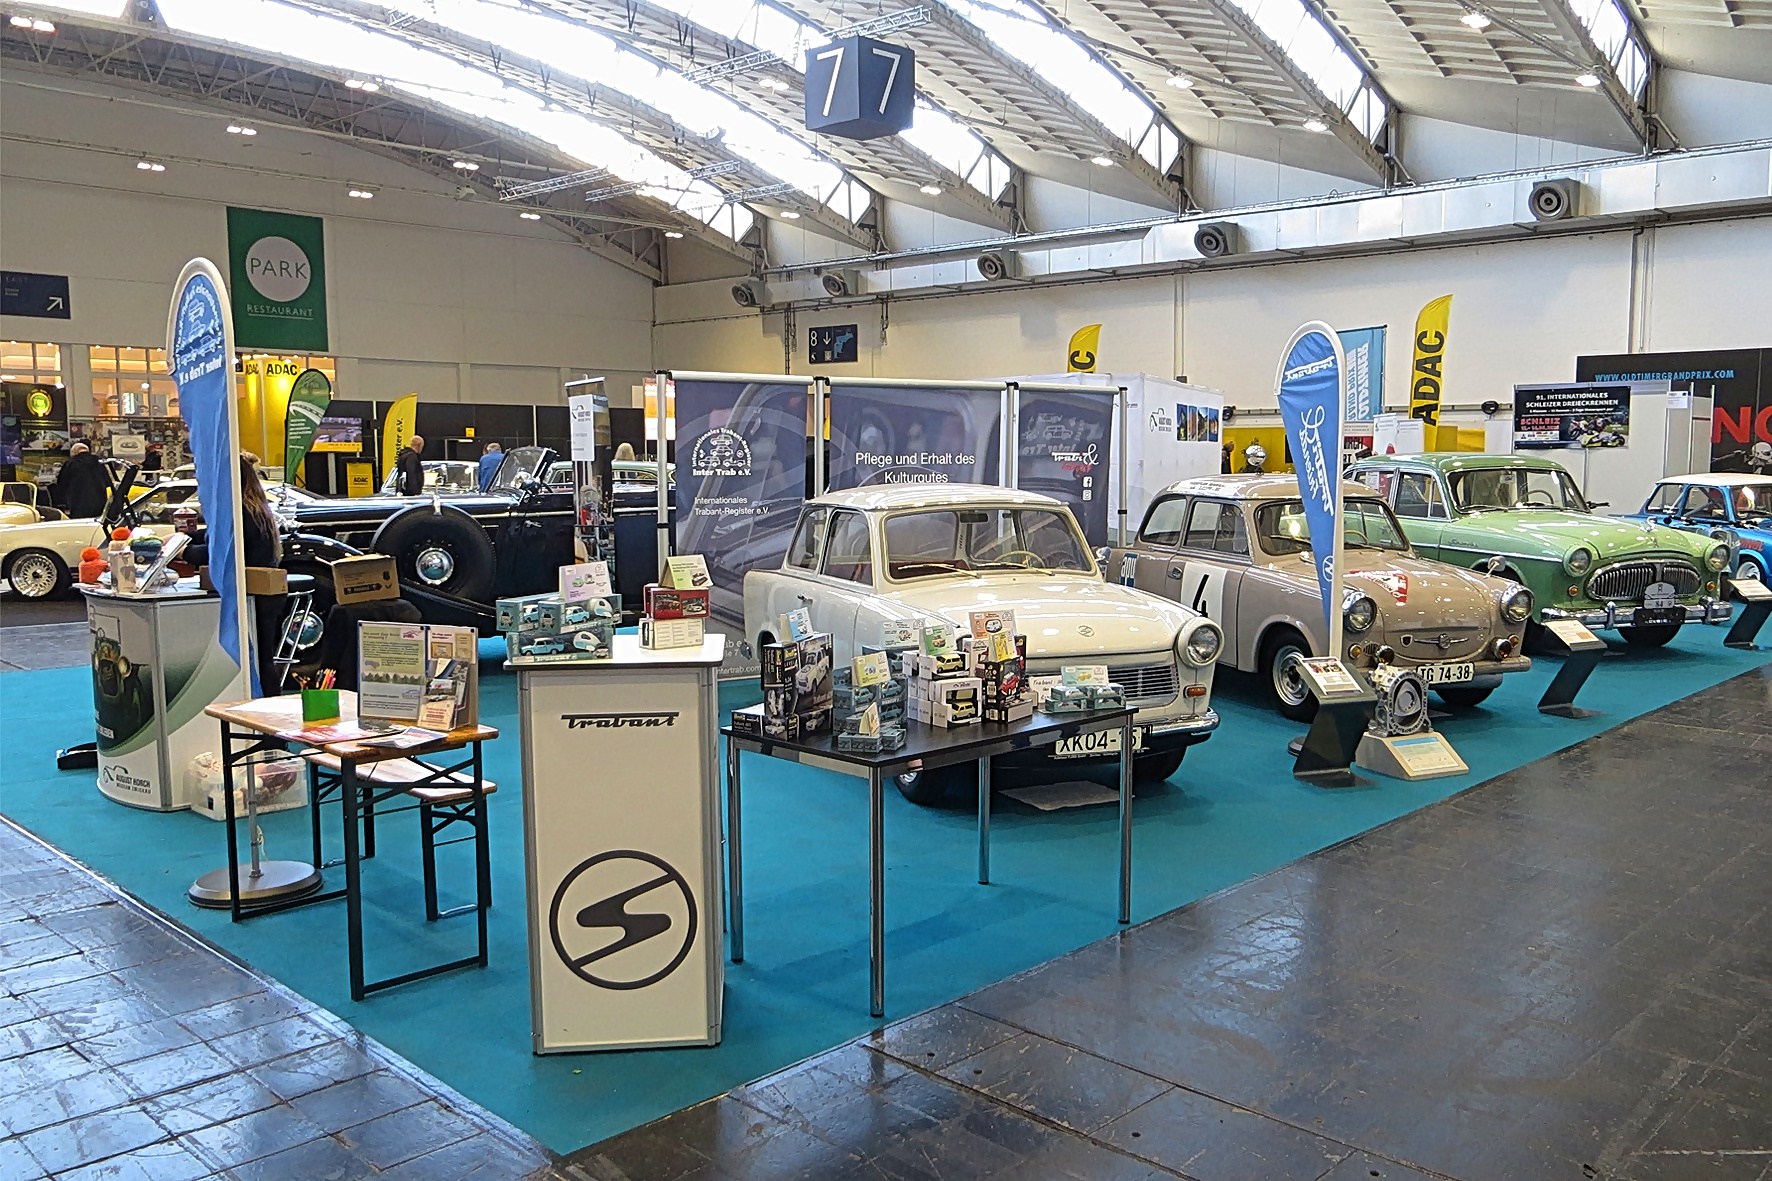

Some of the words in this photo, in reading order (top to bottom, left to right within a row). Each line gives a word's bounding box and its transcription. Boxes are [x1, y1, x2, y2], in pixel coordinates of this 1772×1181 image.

[816, 47, 845, 117] 7
[872, 48, 901, 114] 7
[250, 258, 307, 280] PARK
[247, 304, 313, 316] RESTAURANT
[810, 330, 818, 346] 8
[266, 363, 298, 376] ADAC
[1070, 350, 1095, 373] C
[1412, 330, 1445, 427] ADAC
[1595, 369, 1735, 382] WWW.OLDTIMERGRANDPRIX.COM
[1547, 392, 1609, 401] INTERNATIONALES
[855, 452, 892, 468] Pflege
[895, 452, 917, 465] und
[920, 452, 952, 465] Erhalt
[955, 453, 975, 465] des
[715, 468, 737, 476] Trab
[738, 468, 752, 476] e.V.
[884, 471, 949, 483] Kulturgutes
[694, 496, 748, 505] Internationales
[694, 506, 754, 516] Trabant-Register
[756, 506, 770, 515] e.V.
[1439, 665, 1471, 681] 74-38
[561, 712, 680, 729] Trabant
